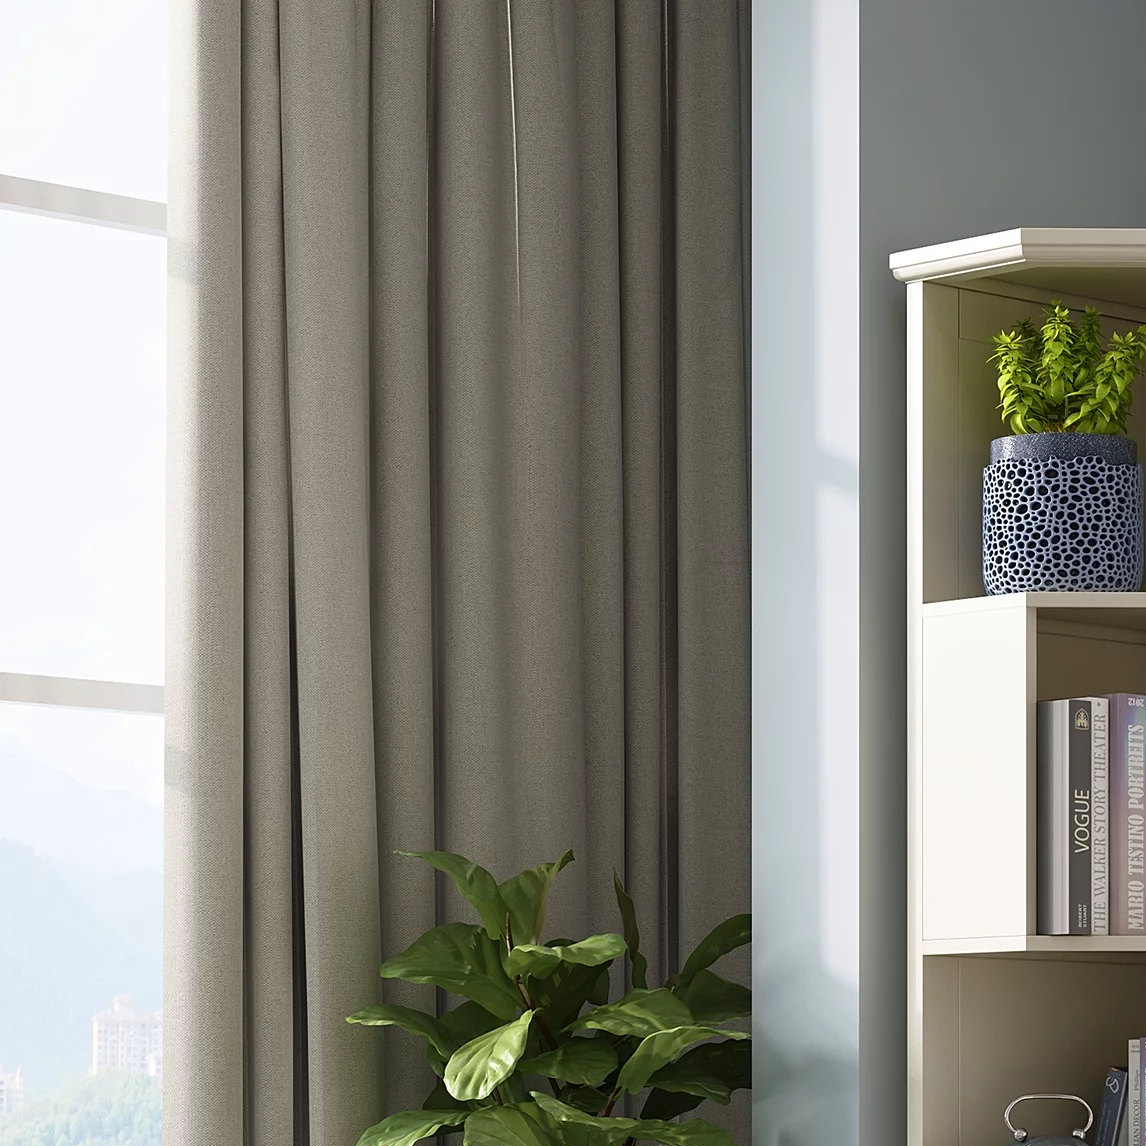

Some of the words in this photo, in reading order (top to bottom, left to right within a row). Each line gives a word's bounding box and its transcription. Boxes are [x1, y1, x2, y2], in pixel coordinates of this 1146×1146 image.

[1128, 697, 1145, 707] 2012
[1093, 714, 1106, 782] THEATER
[1127, 724, 1144, 810] PORTREITS
[1074, 789, 1090, 854] VOGUE
[1093, 786, 1106, 833] STORY
[1093, 838, 1106, 897] WALKER
[1127, 814, 1144, 875] TESTINO
[1093, 902, 1106, 932] THE
[1127, 880, 1144, 930] MARIO
